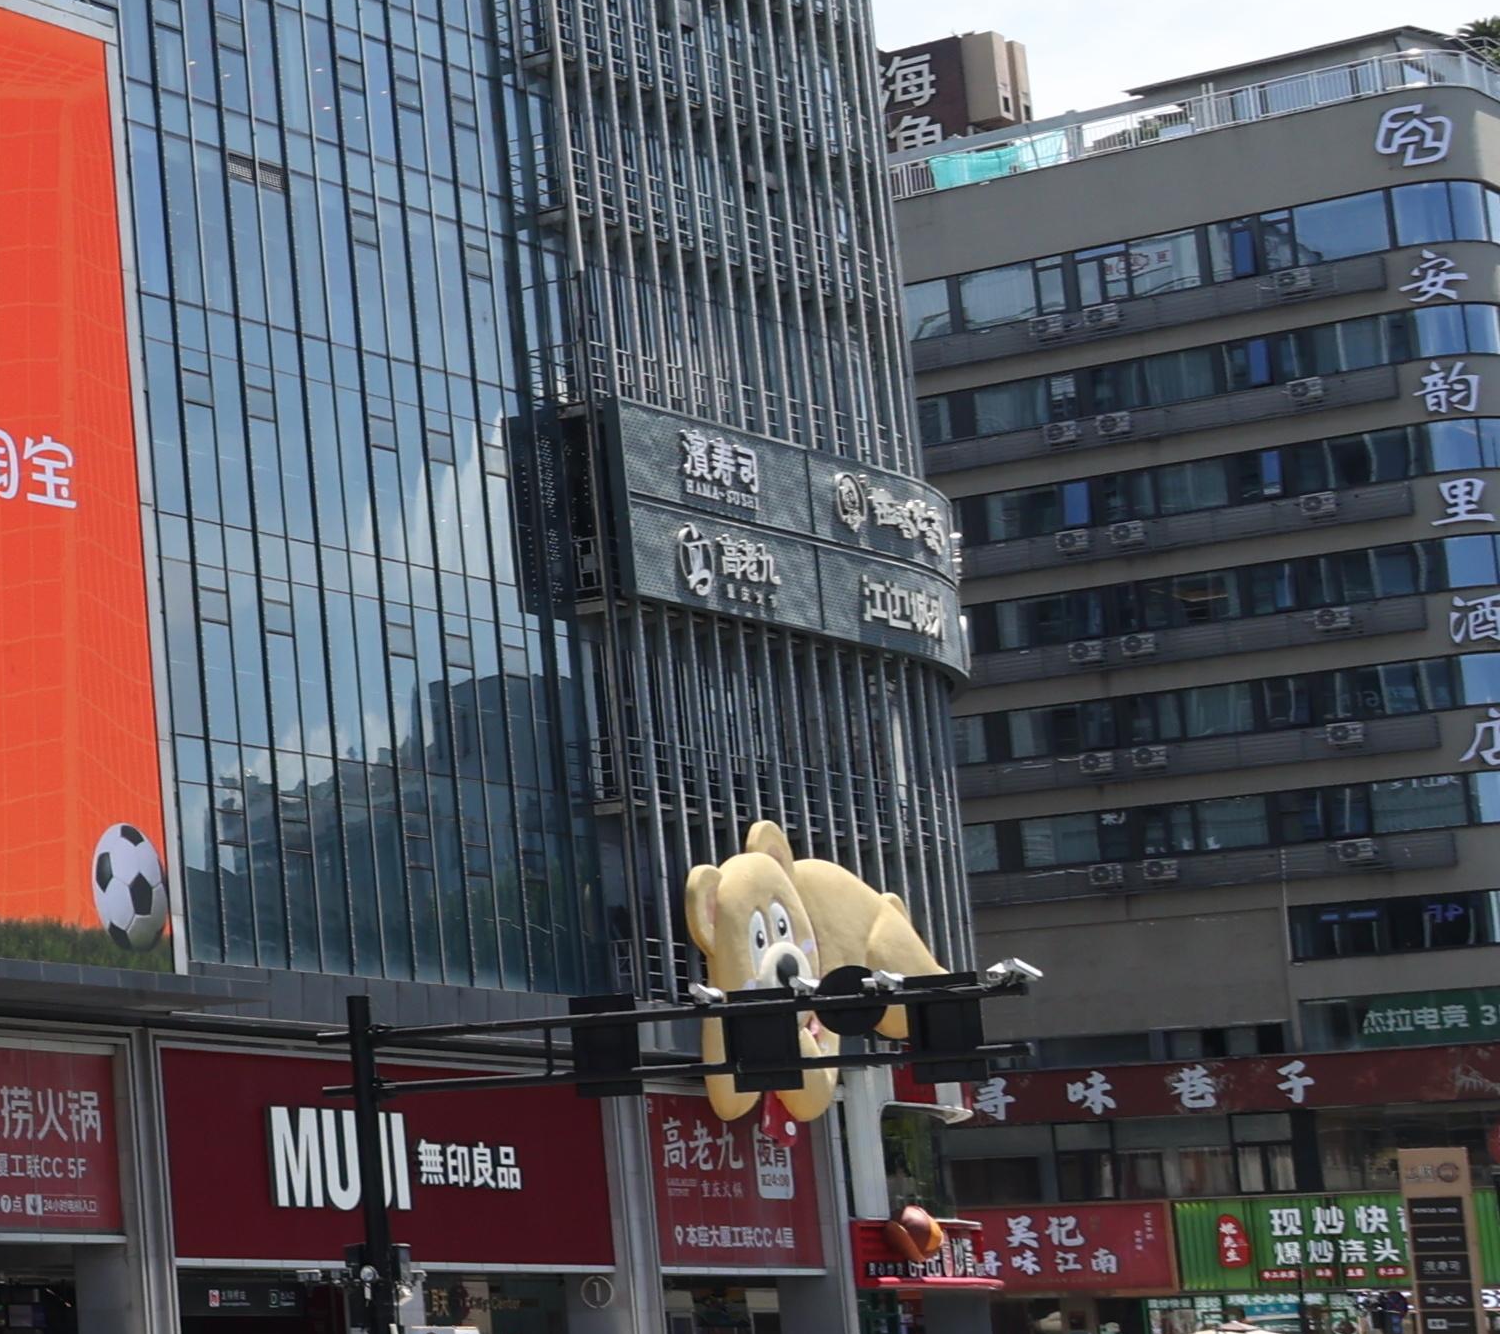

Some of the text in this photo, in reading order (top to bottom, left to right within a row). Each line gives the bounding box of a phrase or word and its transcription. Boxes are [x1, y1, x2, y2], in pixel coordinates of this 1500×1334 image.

[973, 1059, 1317, 1122] 寻味巷子
[67, 1157, 87, 1180] 5F
[418, 1138, 522, 1190] 無印良品
[662, 1116, 745, 1171] 高老九
[1006, 1215, 1086, 1249] 吴记
